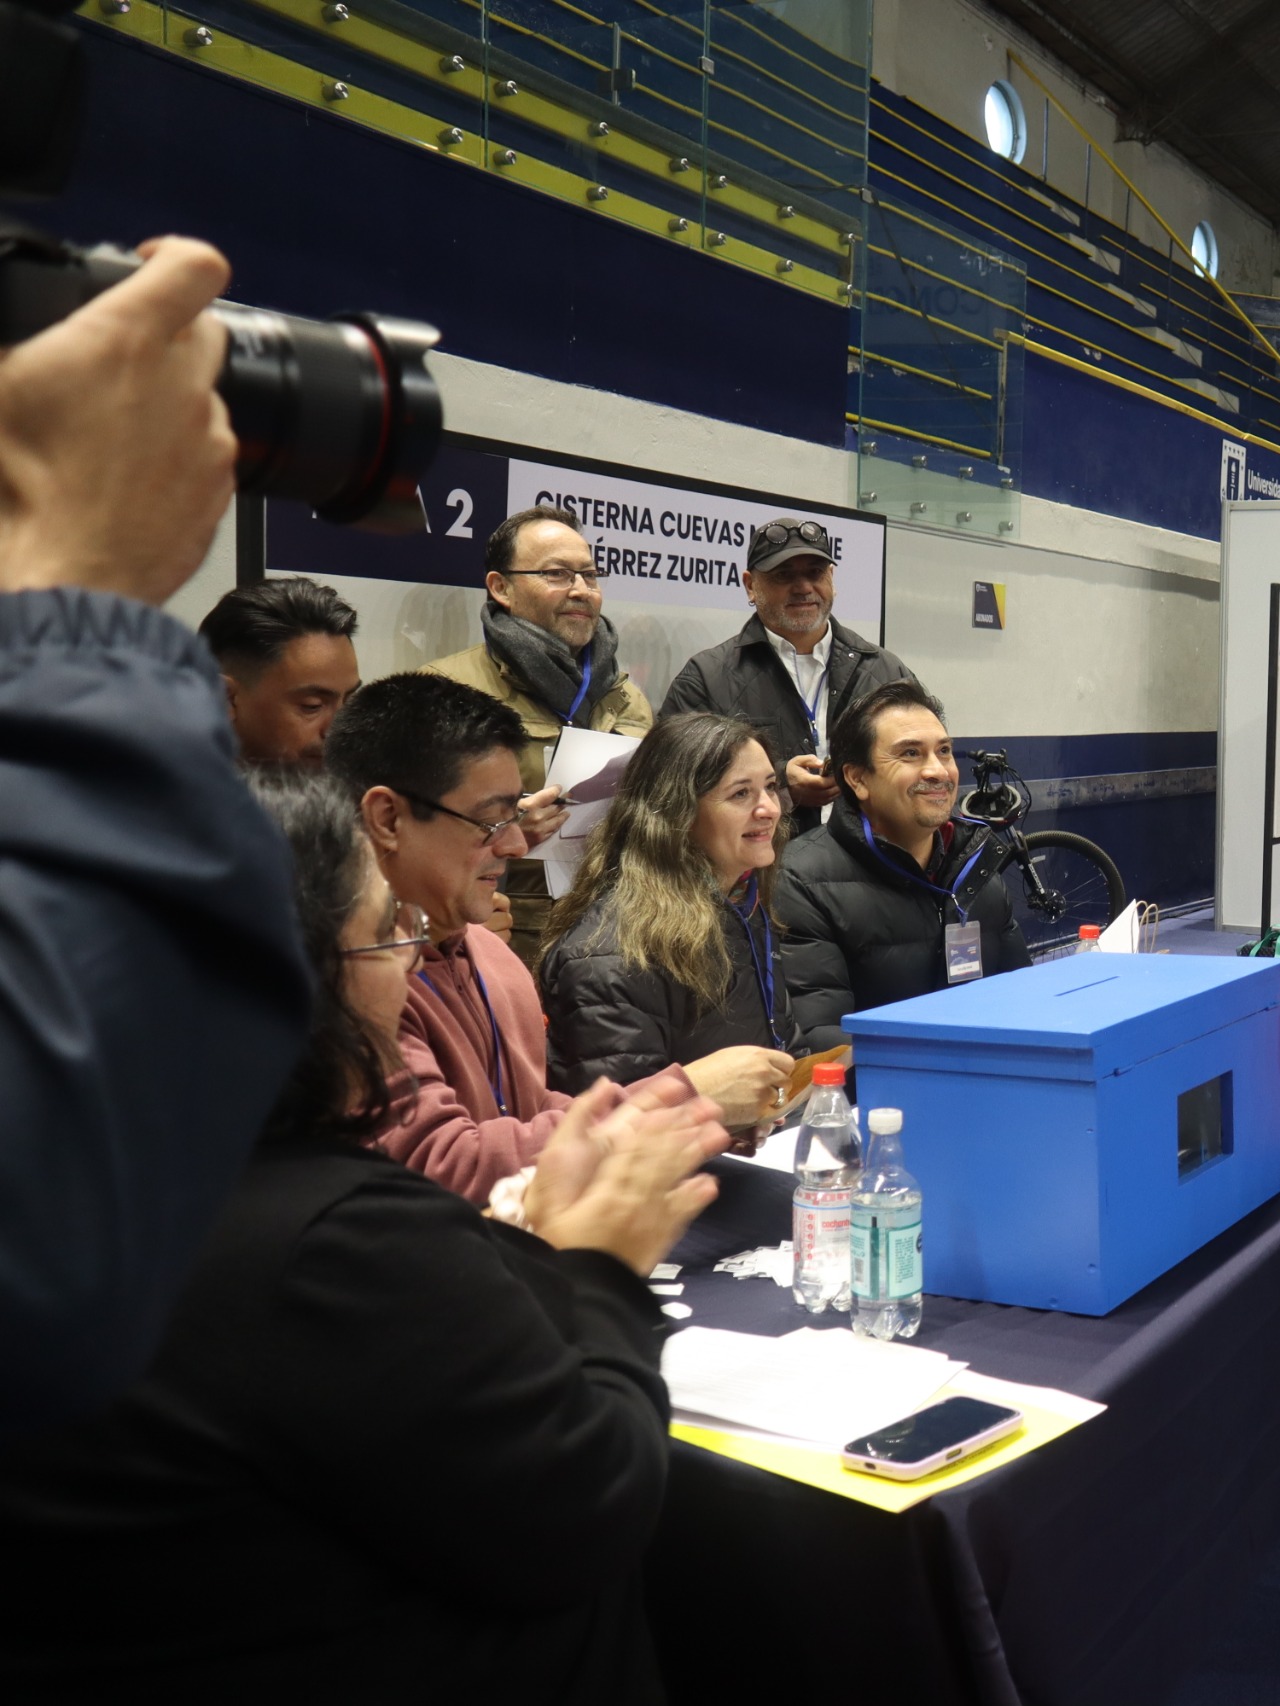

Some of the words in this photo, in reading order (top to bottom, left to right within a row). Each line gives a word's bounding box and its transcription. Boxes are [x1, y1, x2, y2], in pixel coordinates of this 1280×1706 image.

[444, 488, 473, 539] 2
[660, 510, 745, 547] CUEVAS
[589, 536, 662, 579] ÉRREZ
[666, 554, 741, 588] ZURITA
